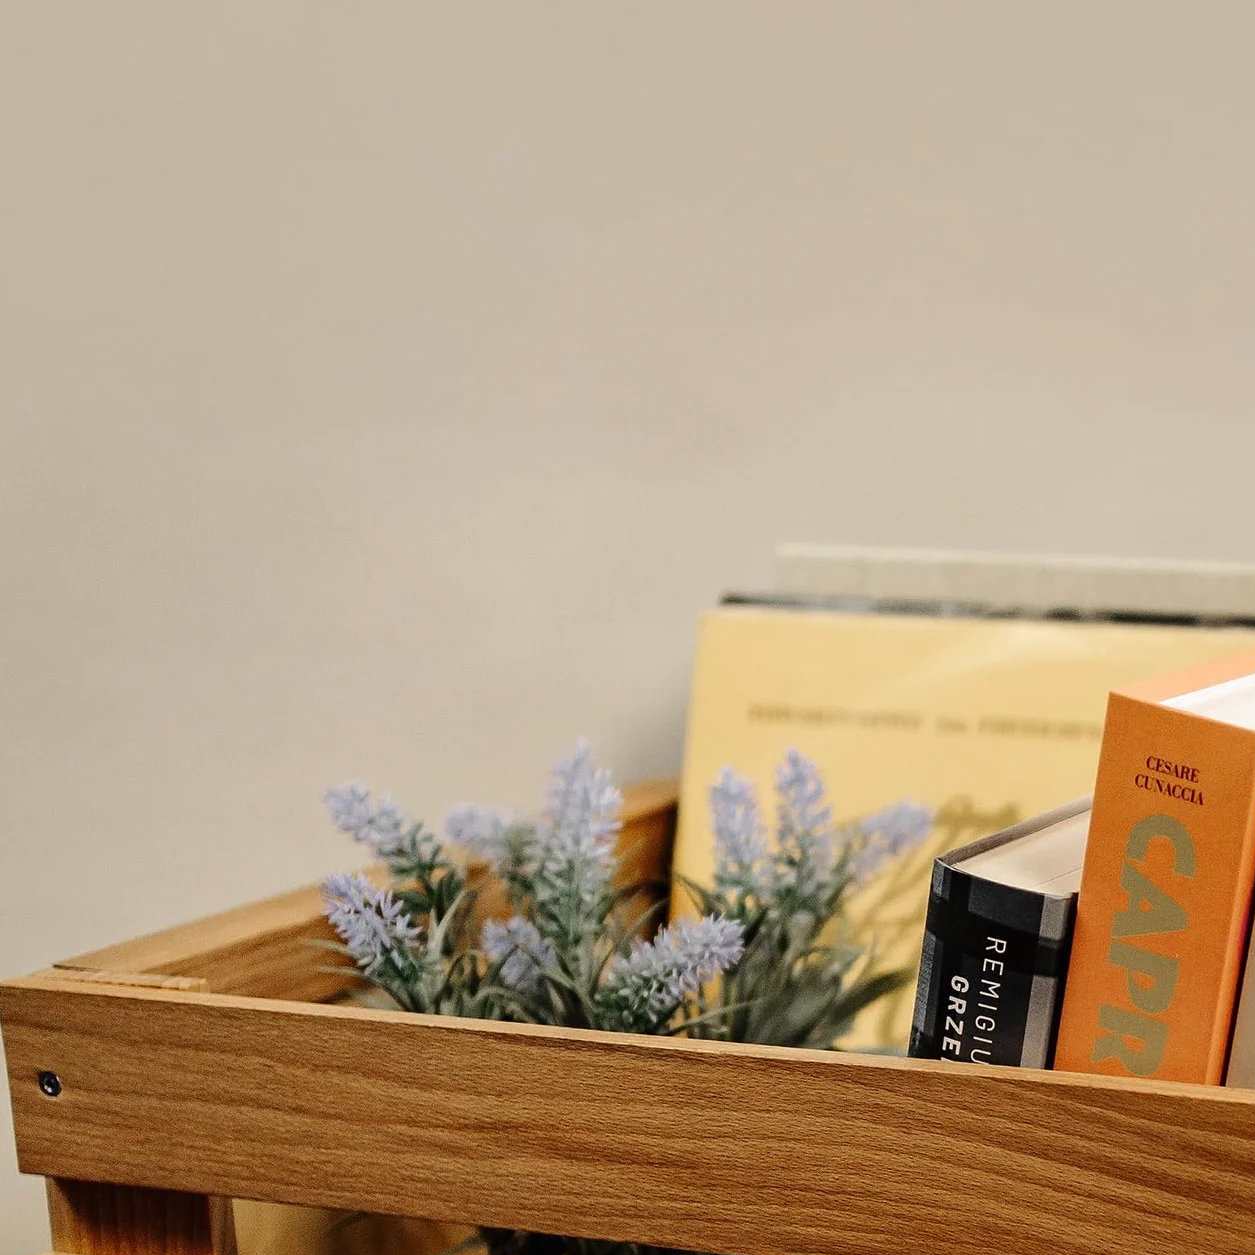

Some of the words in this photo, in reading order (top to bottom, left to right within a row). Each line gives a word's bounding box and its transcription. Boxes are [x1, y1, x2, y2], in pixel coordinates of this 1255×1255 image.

[1146, 756, 1200, 783] CESARE
[1135, 773, 1204, 806] CUNACCIA
[940, 975, 970, 1062] GRZE
